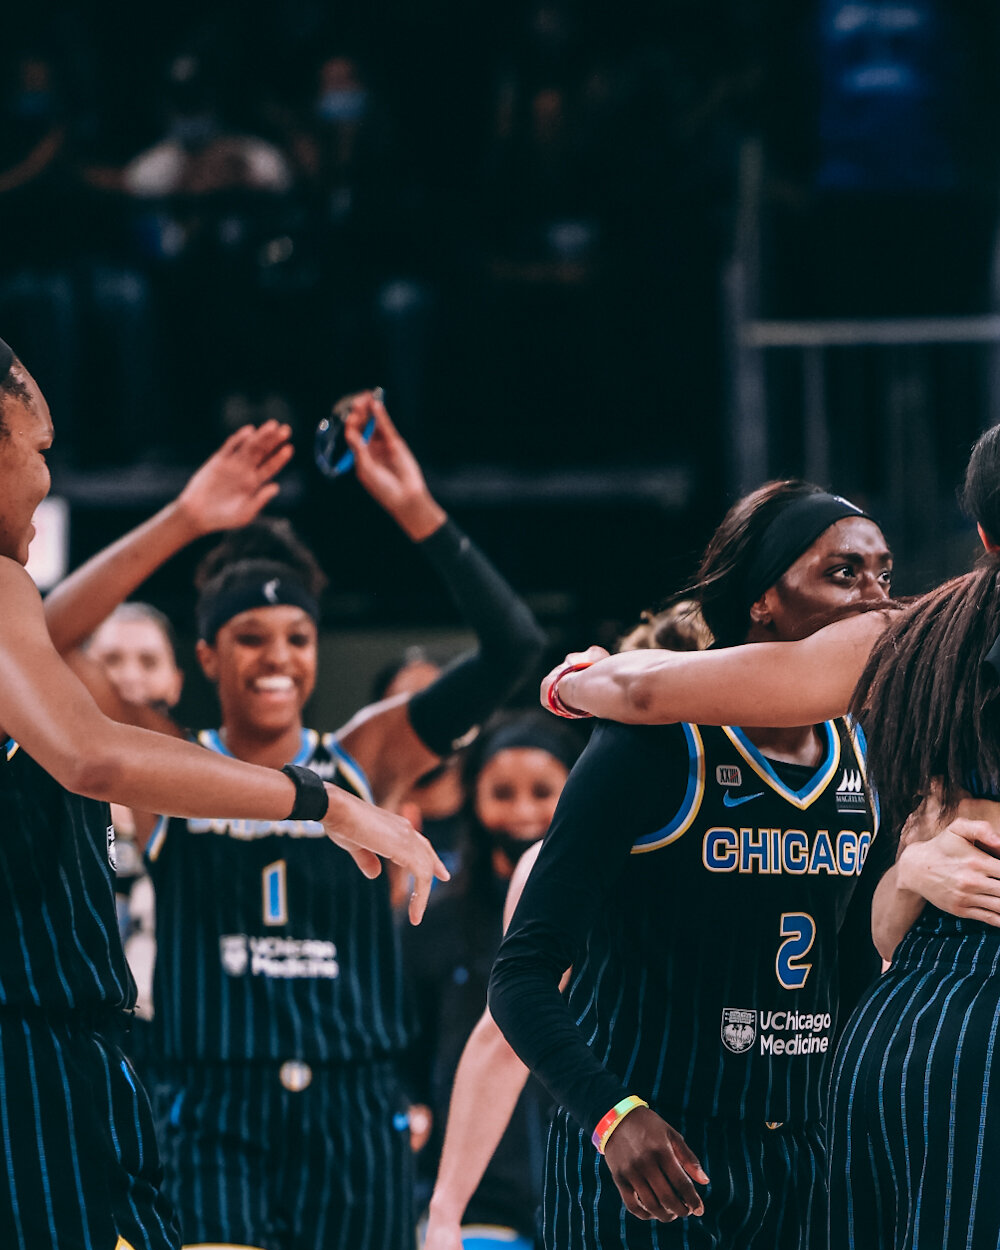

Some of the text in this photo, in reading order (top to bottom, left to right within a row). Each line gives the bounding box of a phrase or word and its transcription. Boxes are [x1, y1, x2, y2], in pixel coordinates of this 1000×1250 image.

[702, 826, 871, 876] CHICAGO
[262, 859, 288, 926] 1
[775, 911, 817, 990] 2
[760, 1010, 831, 1032] UChicago
[760, 1033, 829, 1056] Medicine
